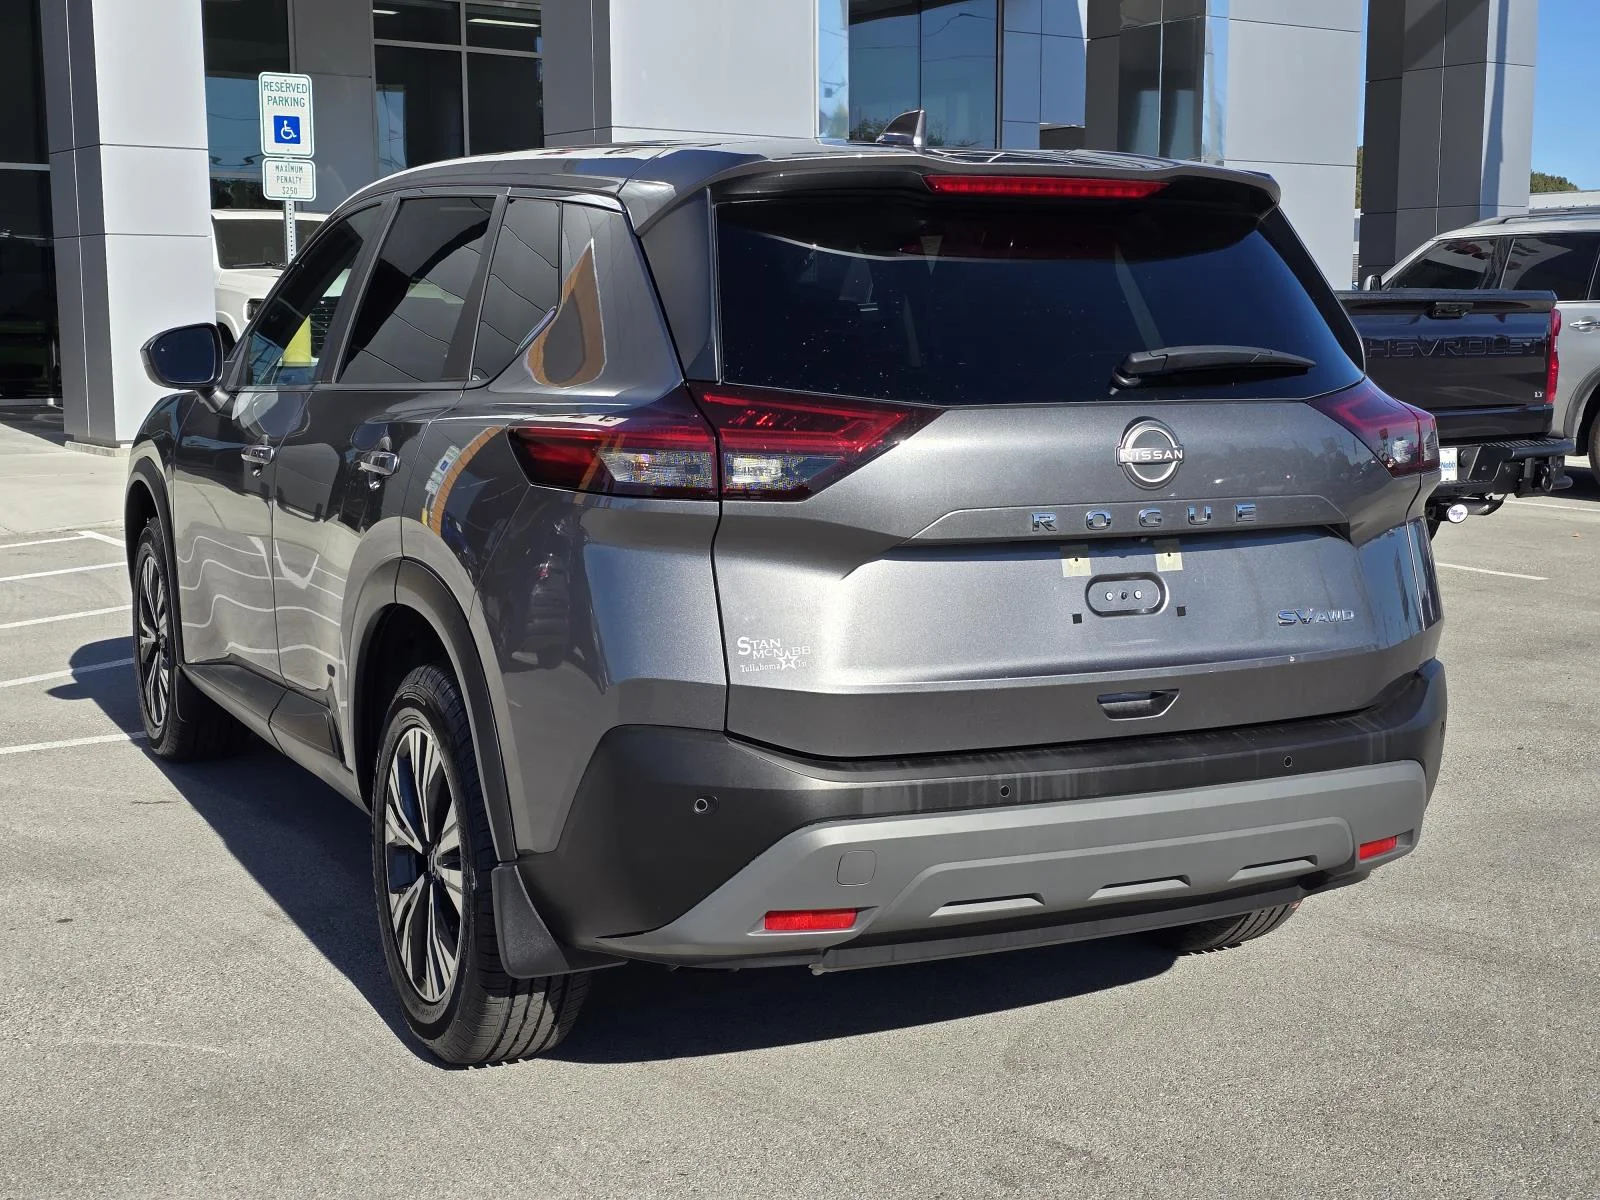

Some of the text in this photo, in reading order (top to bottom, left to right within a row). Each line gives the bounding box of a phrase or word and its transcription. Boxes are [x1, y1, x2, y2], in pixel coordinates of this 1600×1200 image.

[263, 81, 308, 94] RESERVED
[267, 96, 306, 108] PARKING
[275, 164, 303, 173] MAXIMUM
[276, 175, 302, 184] PENALTY
[281, 186, 298, 195] $250
[1365, 336, 1543, 358] HEVROLET
[1121, 449, 1183, 461] NISSAN
[1032, 503, 1256, 532] ROGUE
[1278, 608, 1355, 627] SV AWD
[737, 636, 781, 655] STAN
